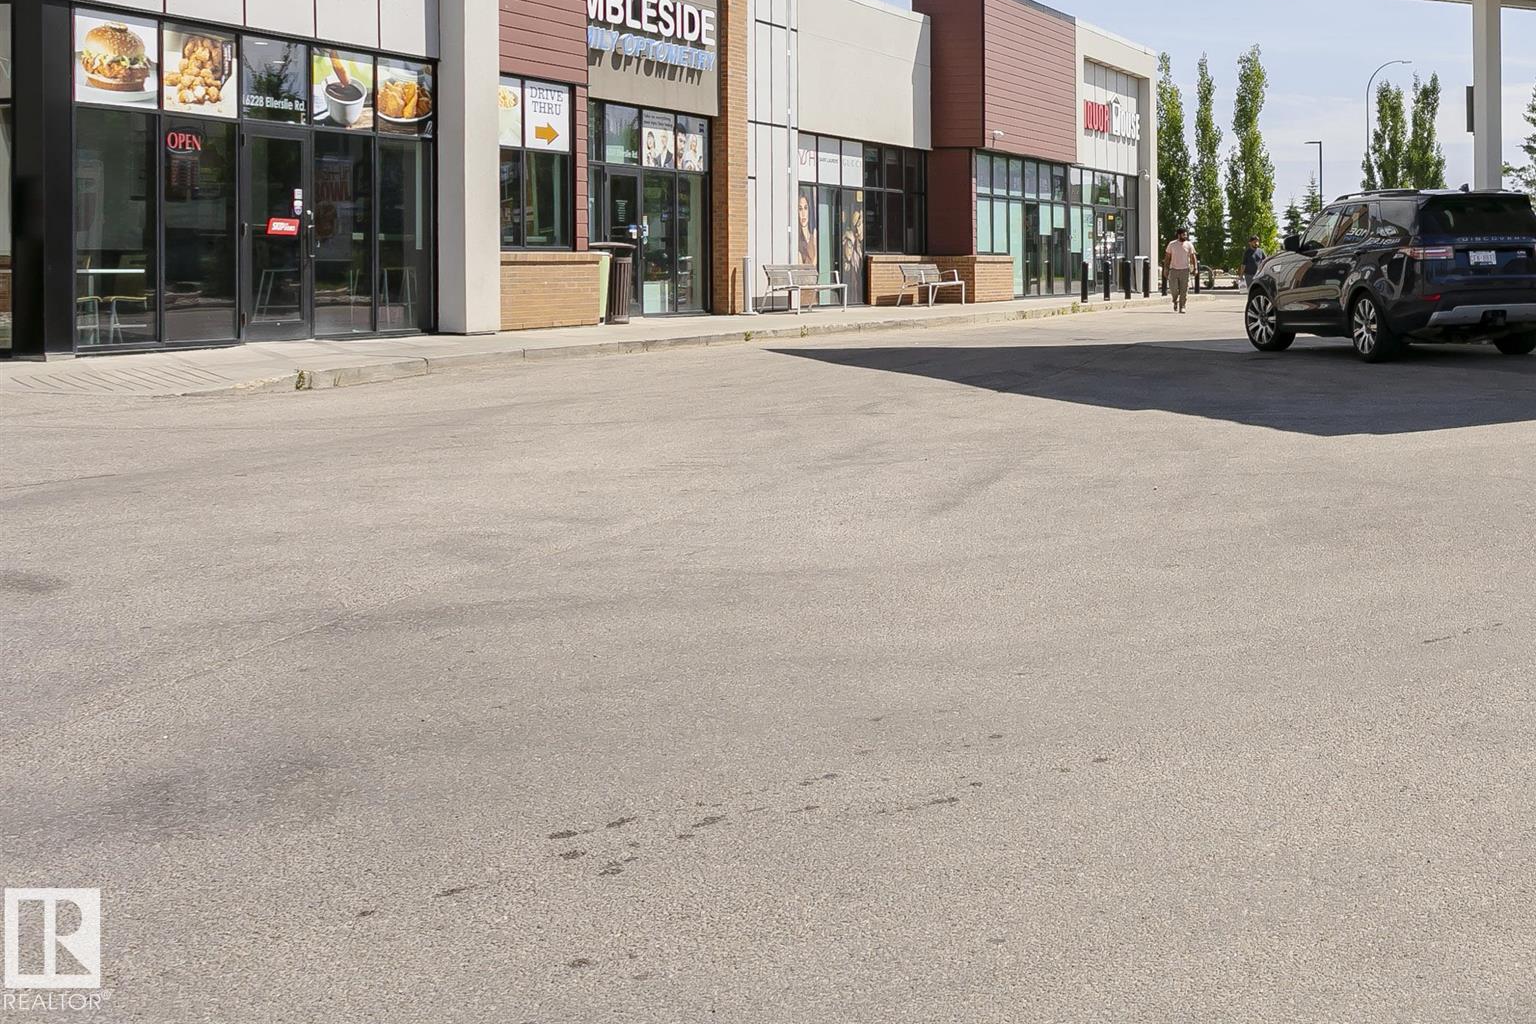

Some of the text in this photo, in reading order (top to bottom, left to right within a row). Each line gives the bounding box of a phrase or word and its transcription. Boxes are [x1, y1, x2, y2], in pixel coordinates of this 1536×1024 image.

[620, 32, 716, 72] OPTOMETRY
[529, 86, 564, 103] DRIVE
[531, 101, 562, 116] THRU
[166, 131, 202, 152] OPEN
